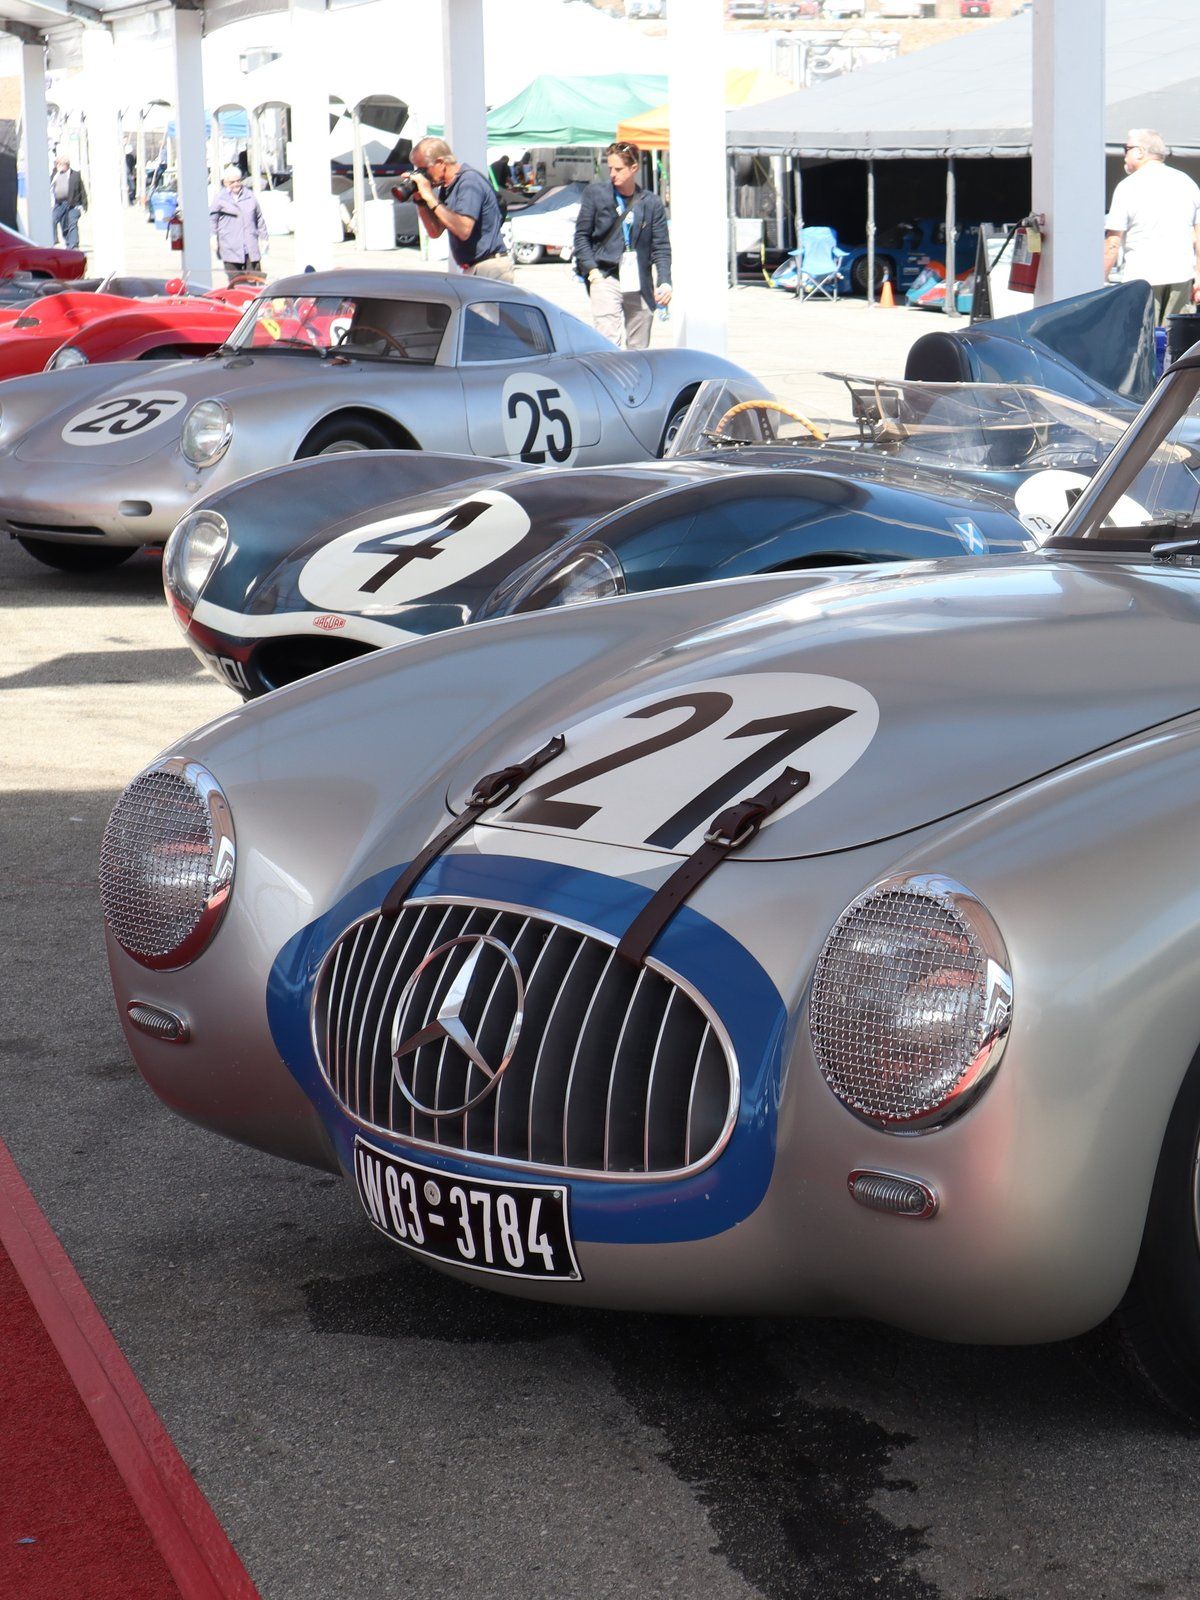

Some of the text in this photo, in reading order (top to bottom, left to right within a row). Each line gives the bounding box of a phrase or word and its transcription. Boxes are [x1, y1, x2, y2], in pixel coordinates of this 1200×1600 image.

[70, 398, 179, 435] 25
[506, 388, 573, 464] 25
[353, 501, 493, 593] 4
[314, 615, 345, 629] JAGUAR
[494, 690, 858, 850] 21
[358, 1150, 555, 1271] W83-3784
